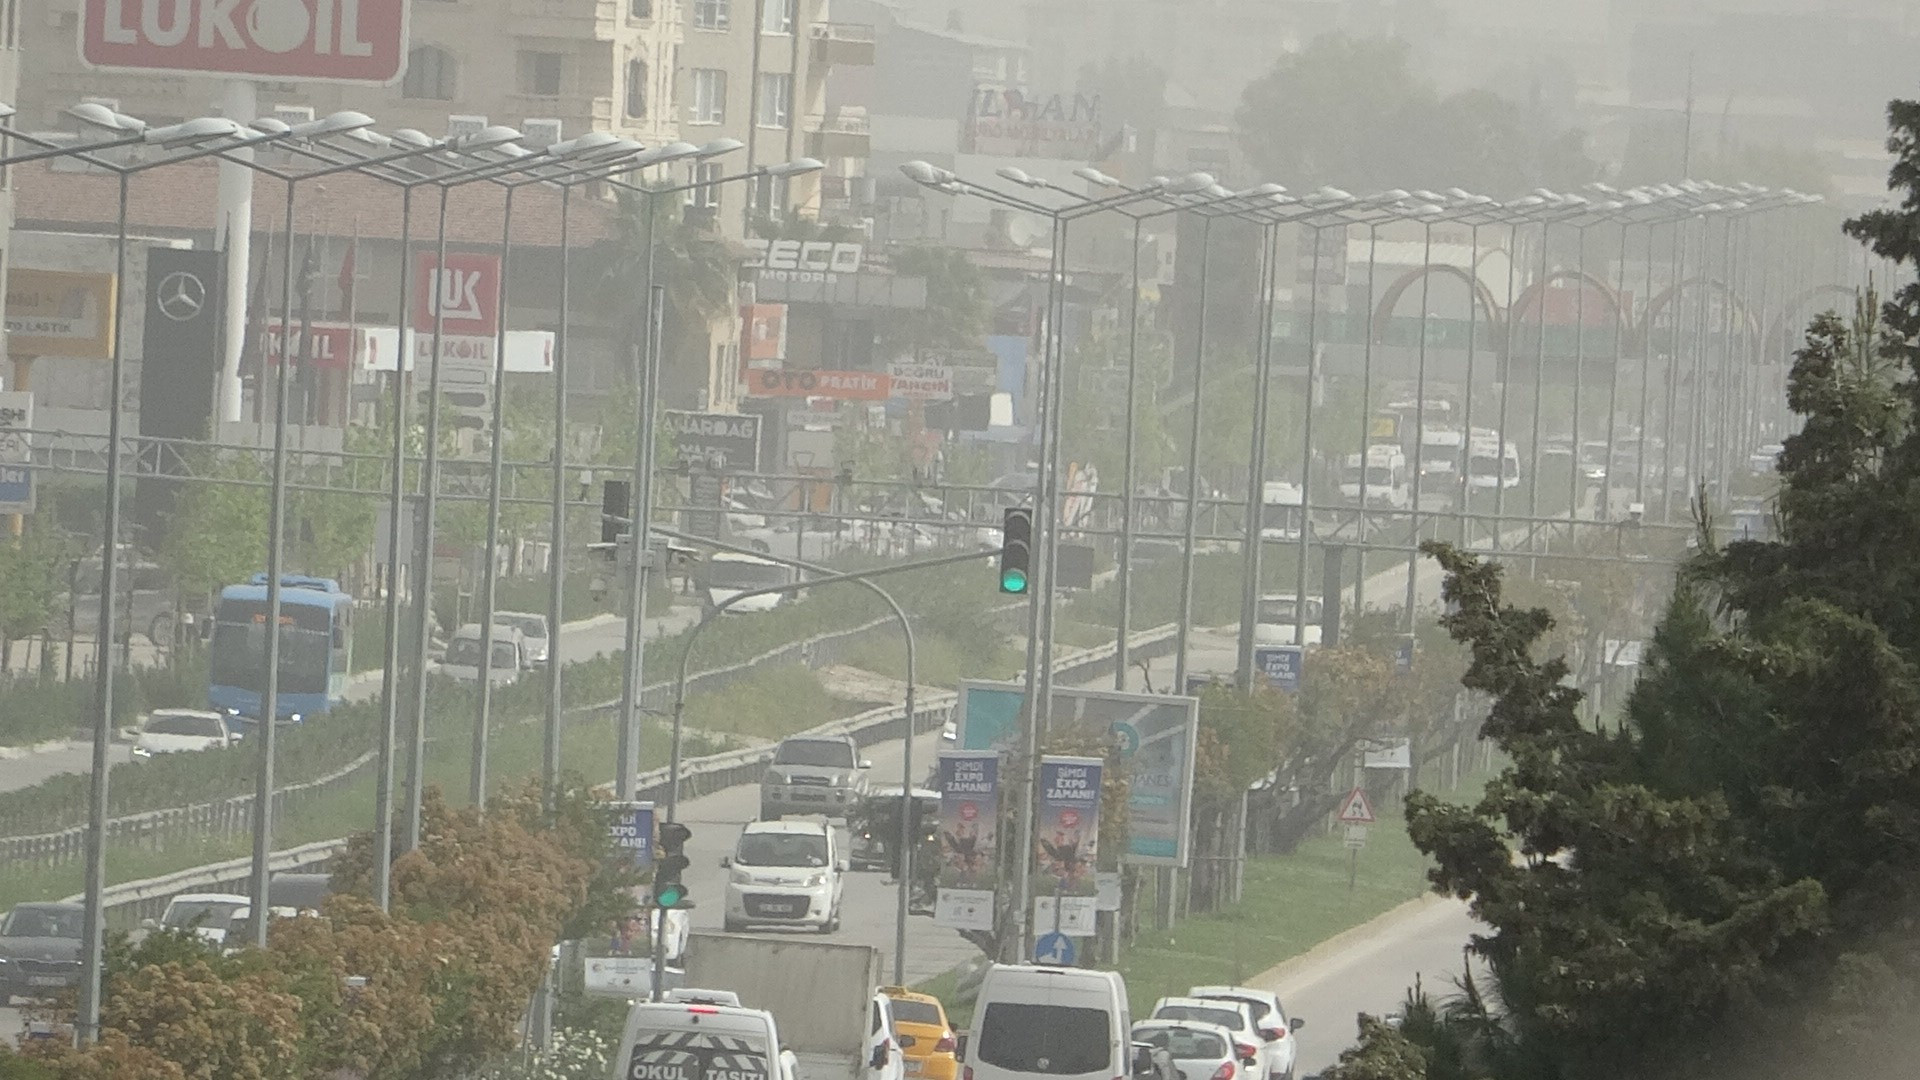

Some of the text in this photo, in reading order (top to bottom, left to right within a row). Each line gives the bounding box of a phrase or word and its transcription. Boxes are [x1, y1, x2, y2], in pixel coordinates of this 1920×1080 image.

[102, 0, 373, 56] LUKOIL
[759, 270, 838, 283] MOTORS
[418, 340, 489, 360] LKOIL
[762, 369, 817, 390] OTO
[954, 761, 984, 772] ŞİMDİ
[1056, 767, 1087, 778] ŞİMDİ
[955, 772, 984, 782] EXPO
[946, 782, 993, 793] ZAMANI!
[1056, 778, 1087, 789] EXPO
[1046, 788, 1095, 800] ZAMANI!
[633, 1064, 690, 1080] OKUL
